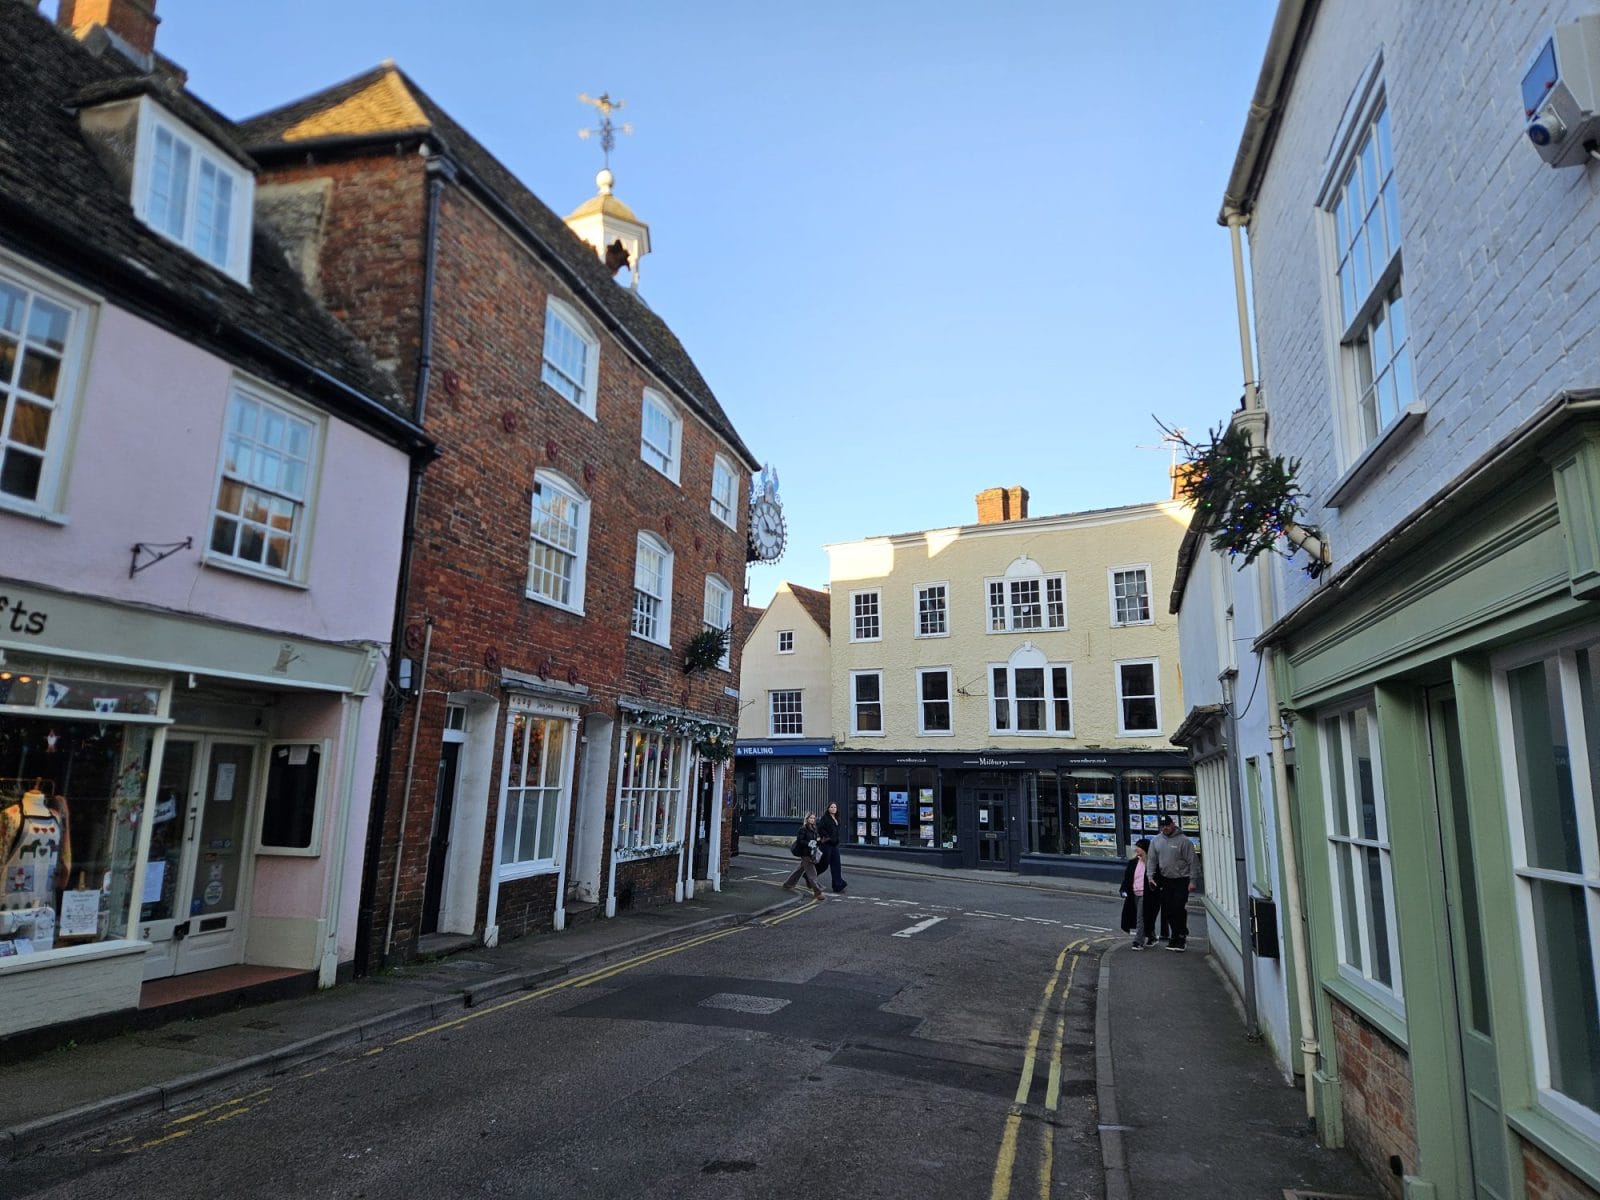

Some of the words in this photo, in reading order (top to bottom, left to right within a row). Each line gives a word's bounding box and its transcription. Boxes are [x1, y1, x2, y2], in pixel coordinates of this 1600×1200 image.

[743, 747, 774, 755] HEALING
[979, 757, 1009, 767] Milburys
[143, 927, 151, 939] 3
